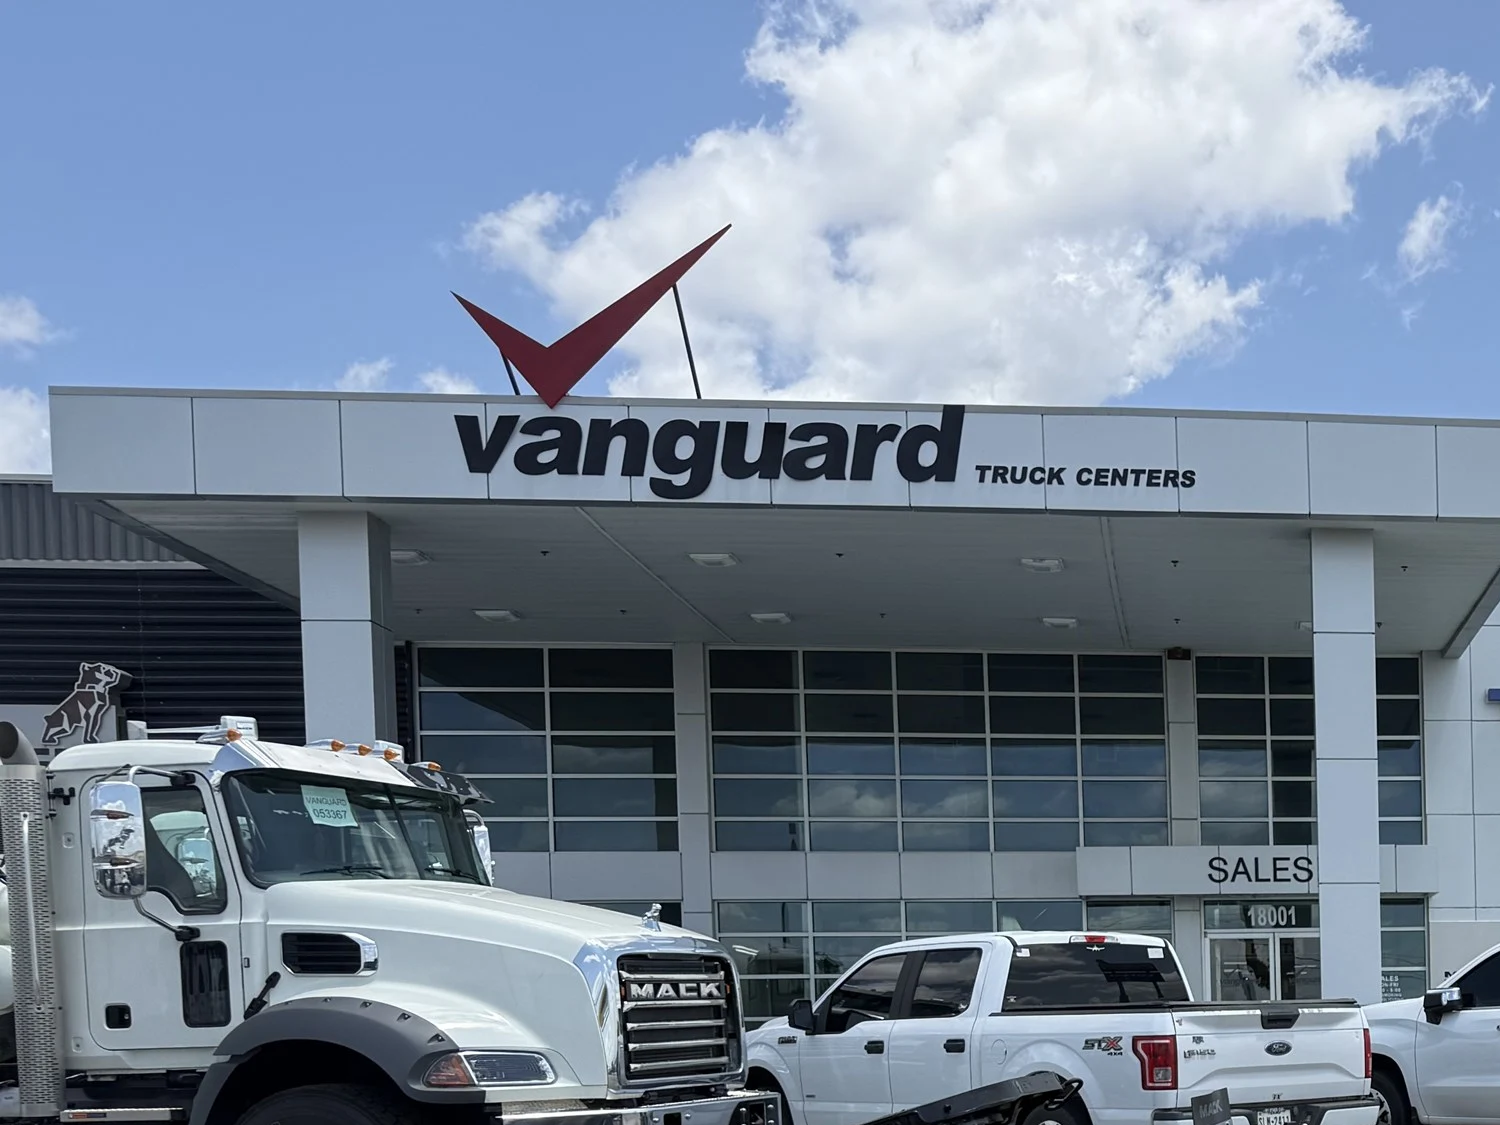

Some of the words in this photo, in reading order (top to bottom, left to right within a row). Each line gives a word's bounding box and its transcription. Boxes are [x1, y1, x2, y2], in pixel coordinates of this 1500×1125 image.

[453, 405, 965, 500] vanguard
[975, 465, 1065, 486] TRUCK
[1076, 467, 1196, 489] CENTERS
[305, 796, 348, 807] VANGUARD
[312, 808, 347, 820] 053367
[1207, 856, 1314, 883] SALES
[1247, 905, 1296, 927] 18001
[629, 982, 722, 999] MACK
[1082, 1036, 1123, 1051] STX
[1199, 1099, 1223, 1118] MACK
